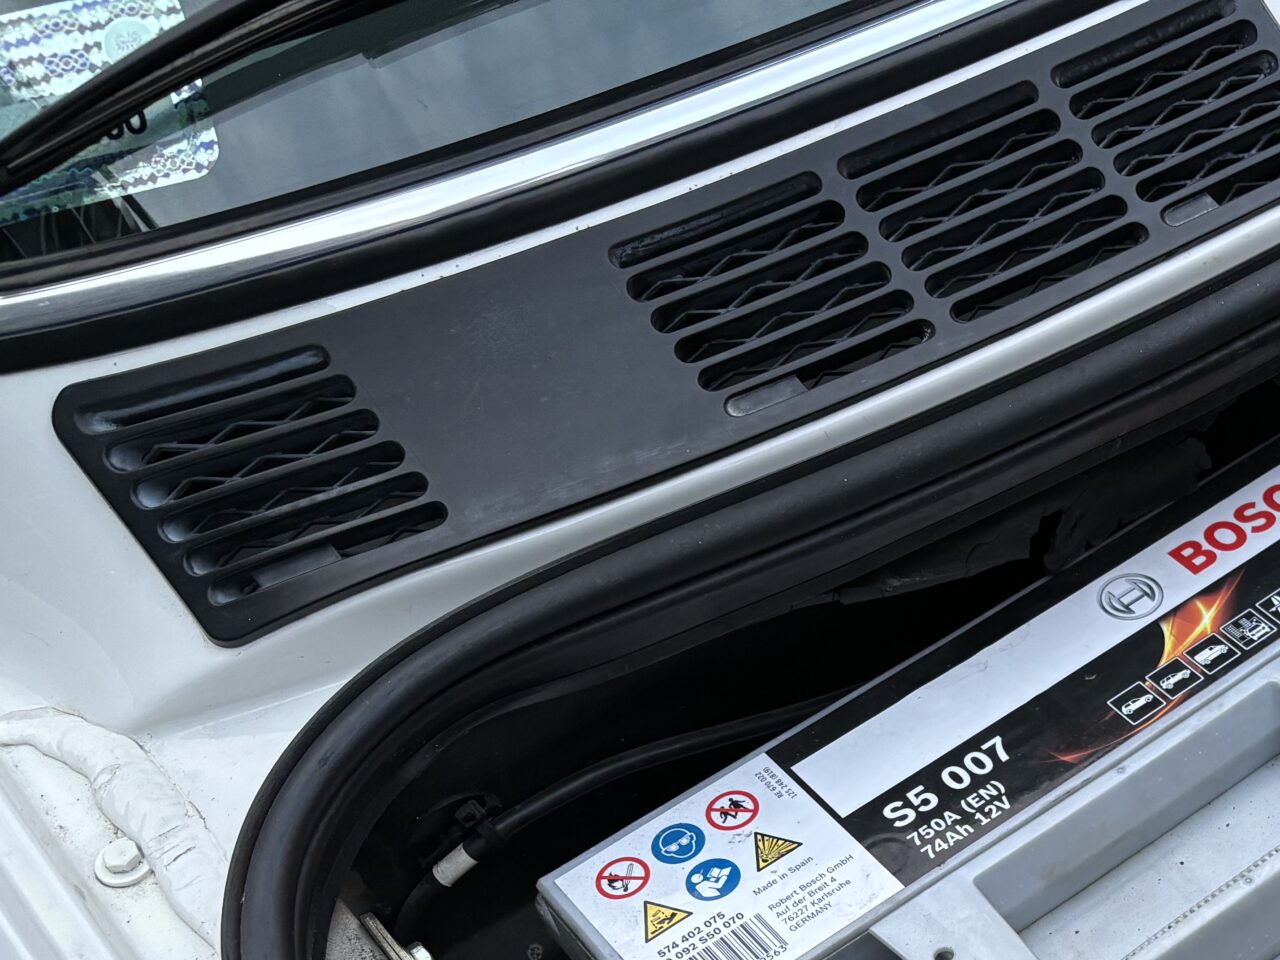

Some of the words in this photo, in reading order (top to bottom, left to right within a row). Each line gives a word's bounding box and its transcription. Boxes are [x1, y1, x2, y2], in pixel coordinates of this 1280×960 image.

[775, 778, 788, 790] 248
[882, 785, 939, 828] S5
[941, 735, 1010, 790] 007
[906, 810, 962, 846] 750A
[961, 780, 1006, 813] (EN)
[920, 823, 974, 859] 74Ah
[974, 795, 1011, 826] 12V
[752, 879, 778, 896] Made
[777, 872, 789, 881] in
[788, 856, 814, 874] Spain
[768, 890, 800, 911] Robert
[799, 873, 827, 892] Bosch
[826, 854, 855, 874] GmbH
[775, 905, 791, 918] Auf
[792, 895, 807, 908] der
[807, 881, 830, 898] Breit
[781, 905, 809, 925] 76227
[810, 879, 852, 907] Karlsruhe
[789, 901, 833, 932] GERMANY
[657, 941, 680, 958] 574
[681, 926, 704, 943] 402
[703, 911, 726, 928] 075
[675, 942, 698, 960] 092
[699, 927, 722, 944] S50
[722, 912, 745, 929] 070
